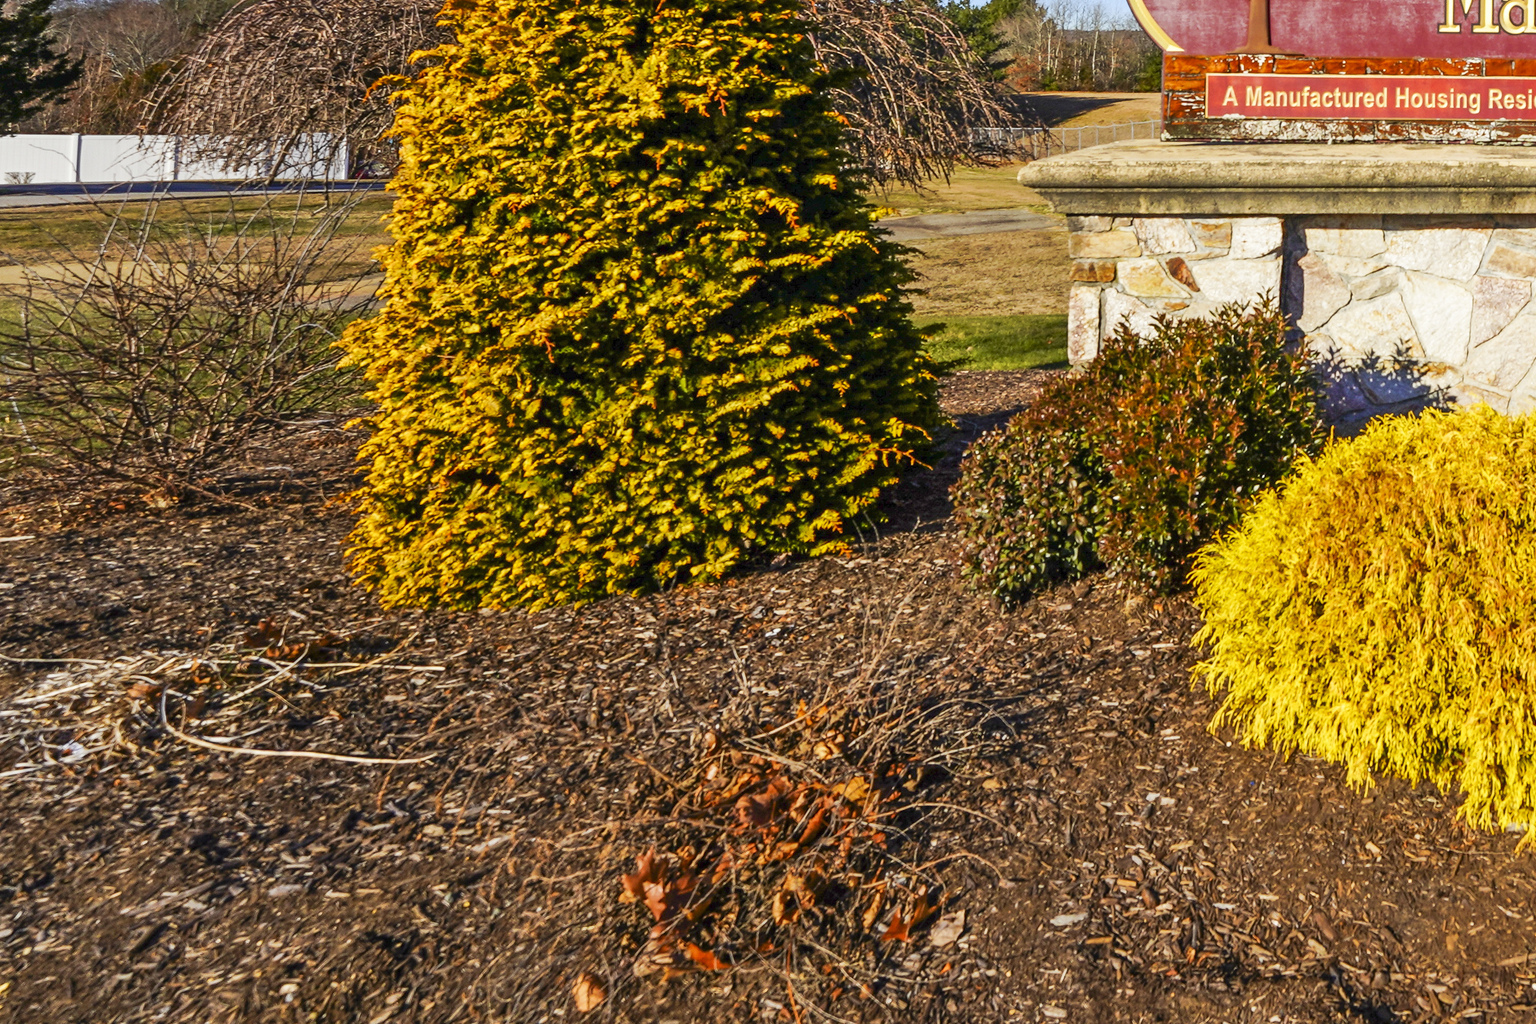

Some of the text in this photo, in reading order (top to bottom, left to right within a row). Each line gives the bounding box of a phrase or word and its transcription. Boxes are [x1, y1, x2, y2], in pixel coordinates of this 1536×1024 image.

[1222, 86, 1238, 106] A
[1245, 86, 1388, 108] Manufactured
[1395, 87, 1481, 114] Housing
